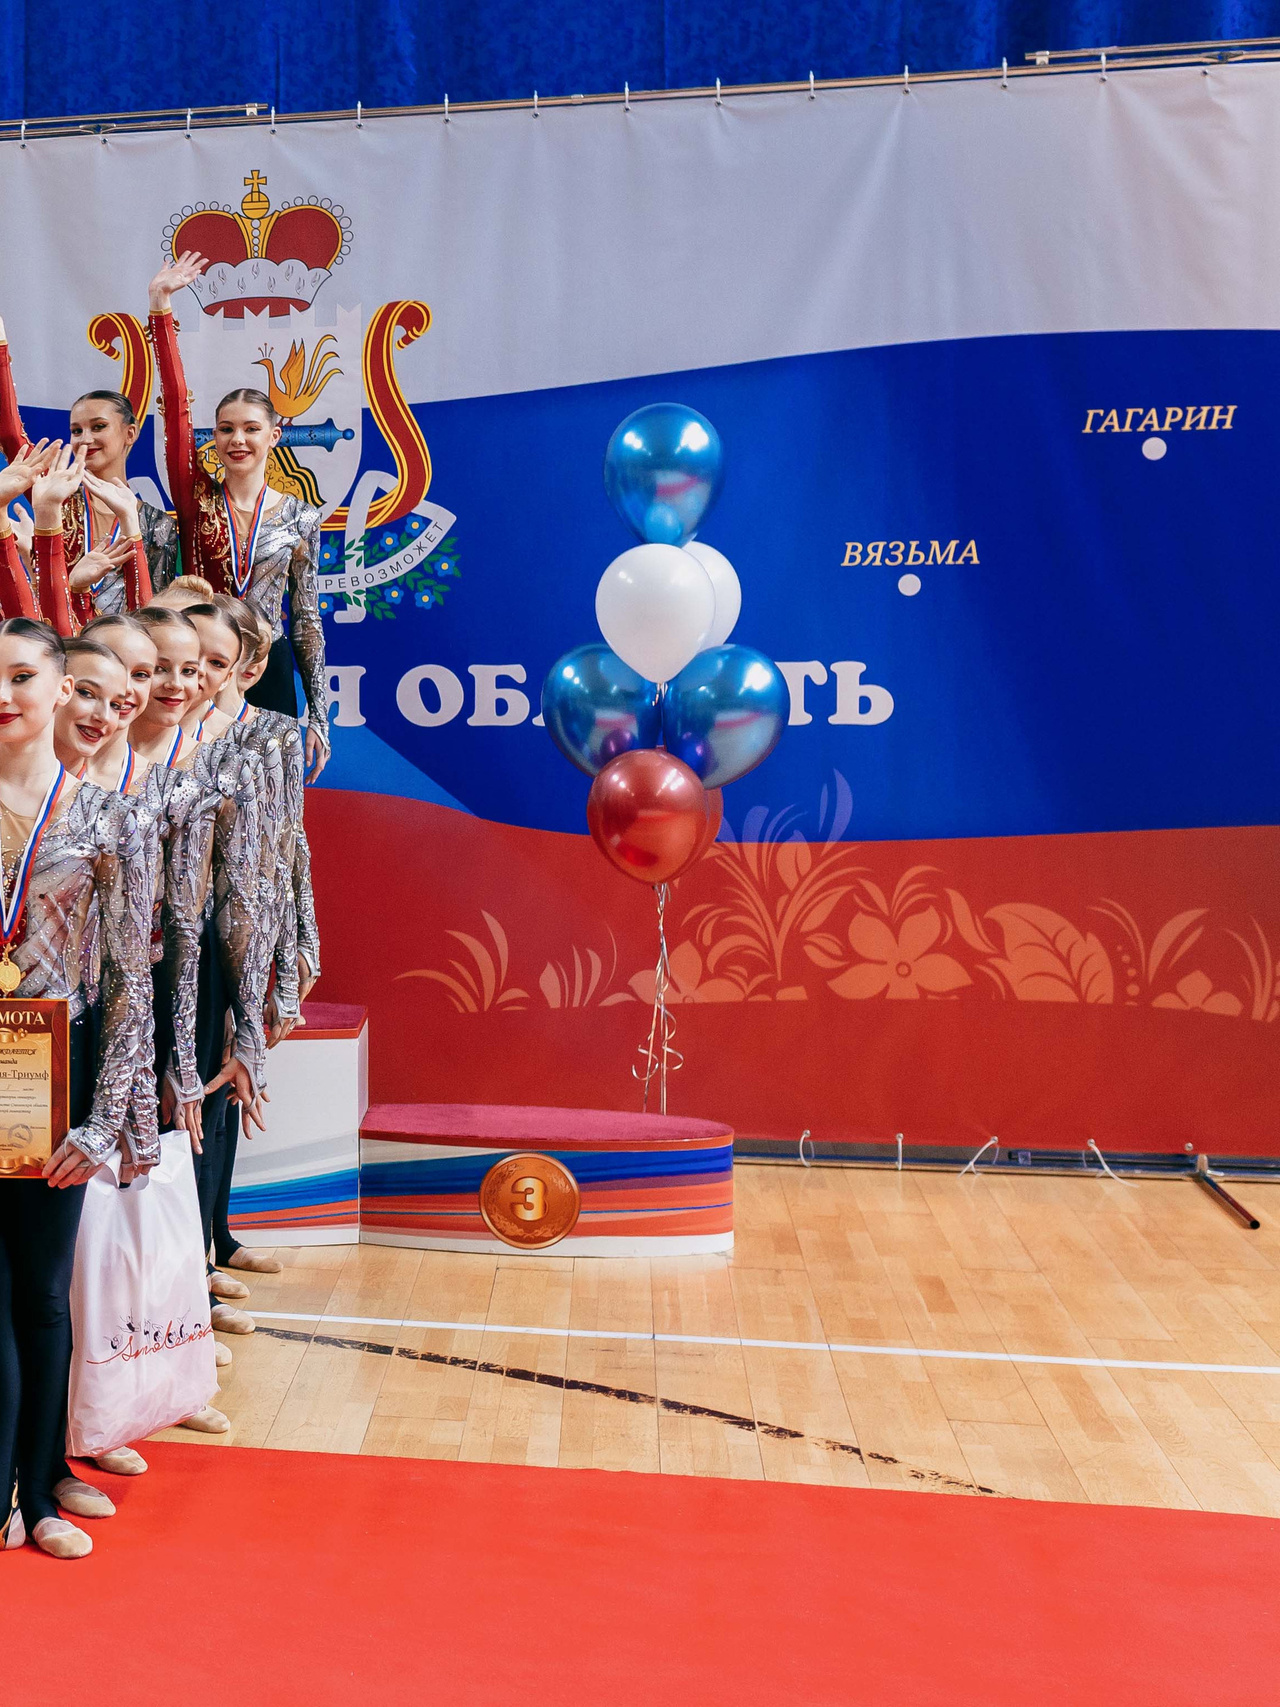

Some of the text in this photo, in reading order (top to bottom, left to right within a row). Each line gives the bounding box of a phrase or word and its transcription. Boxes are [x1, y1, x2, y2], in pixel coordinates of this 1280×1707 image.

[1082, 405, 1238, 434] ГАГАРИН
[316, 521, 444, 591] РЕВОЗМОЖЕТ
[841, 540, 980, 567] ВЯЗЬМА
[396, 660, 895, 727] ОБТЬ
[511, 1176, 547, 1222] 3
